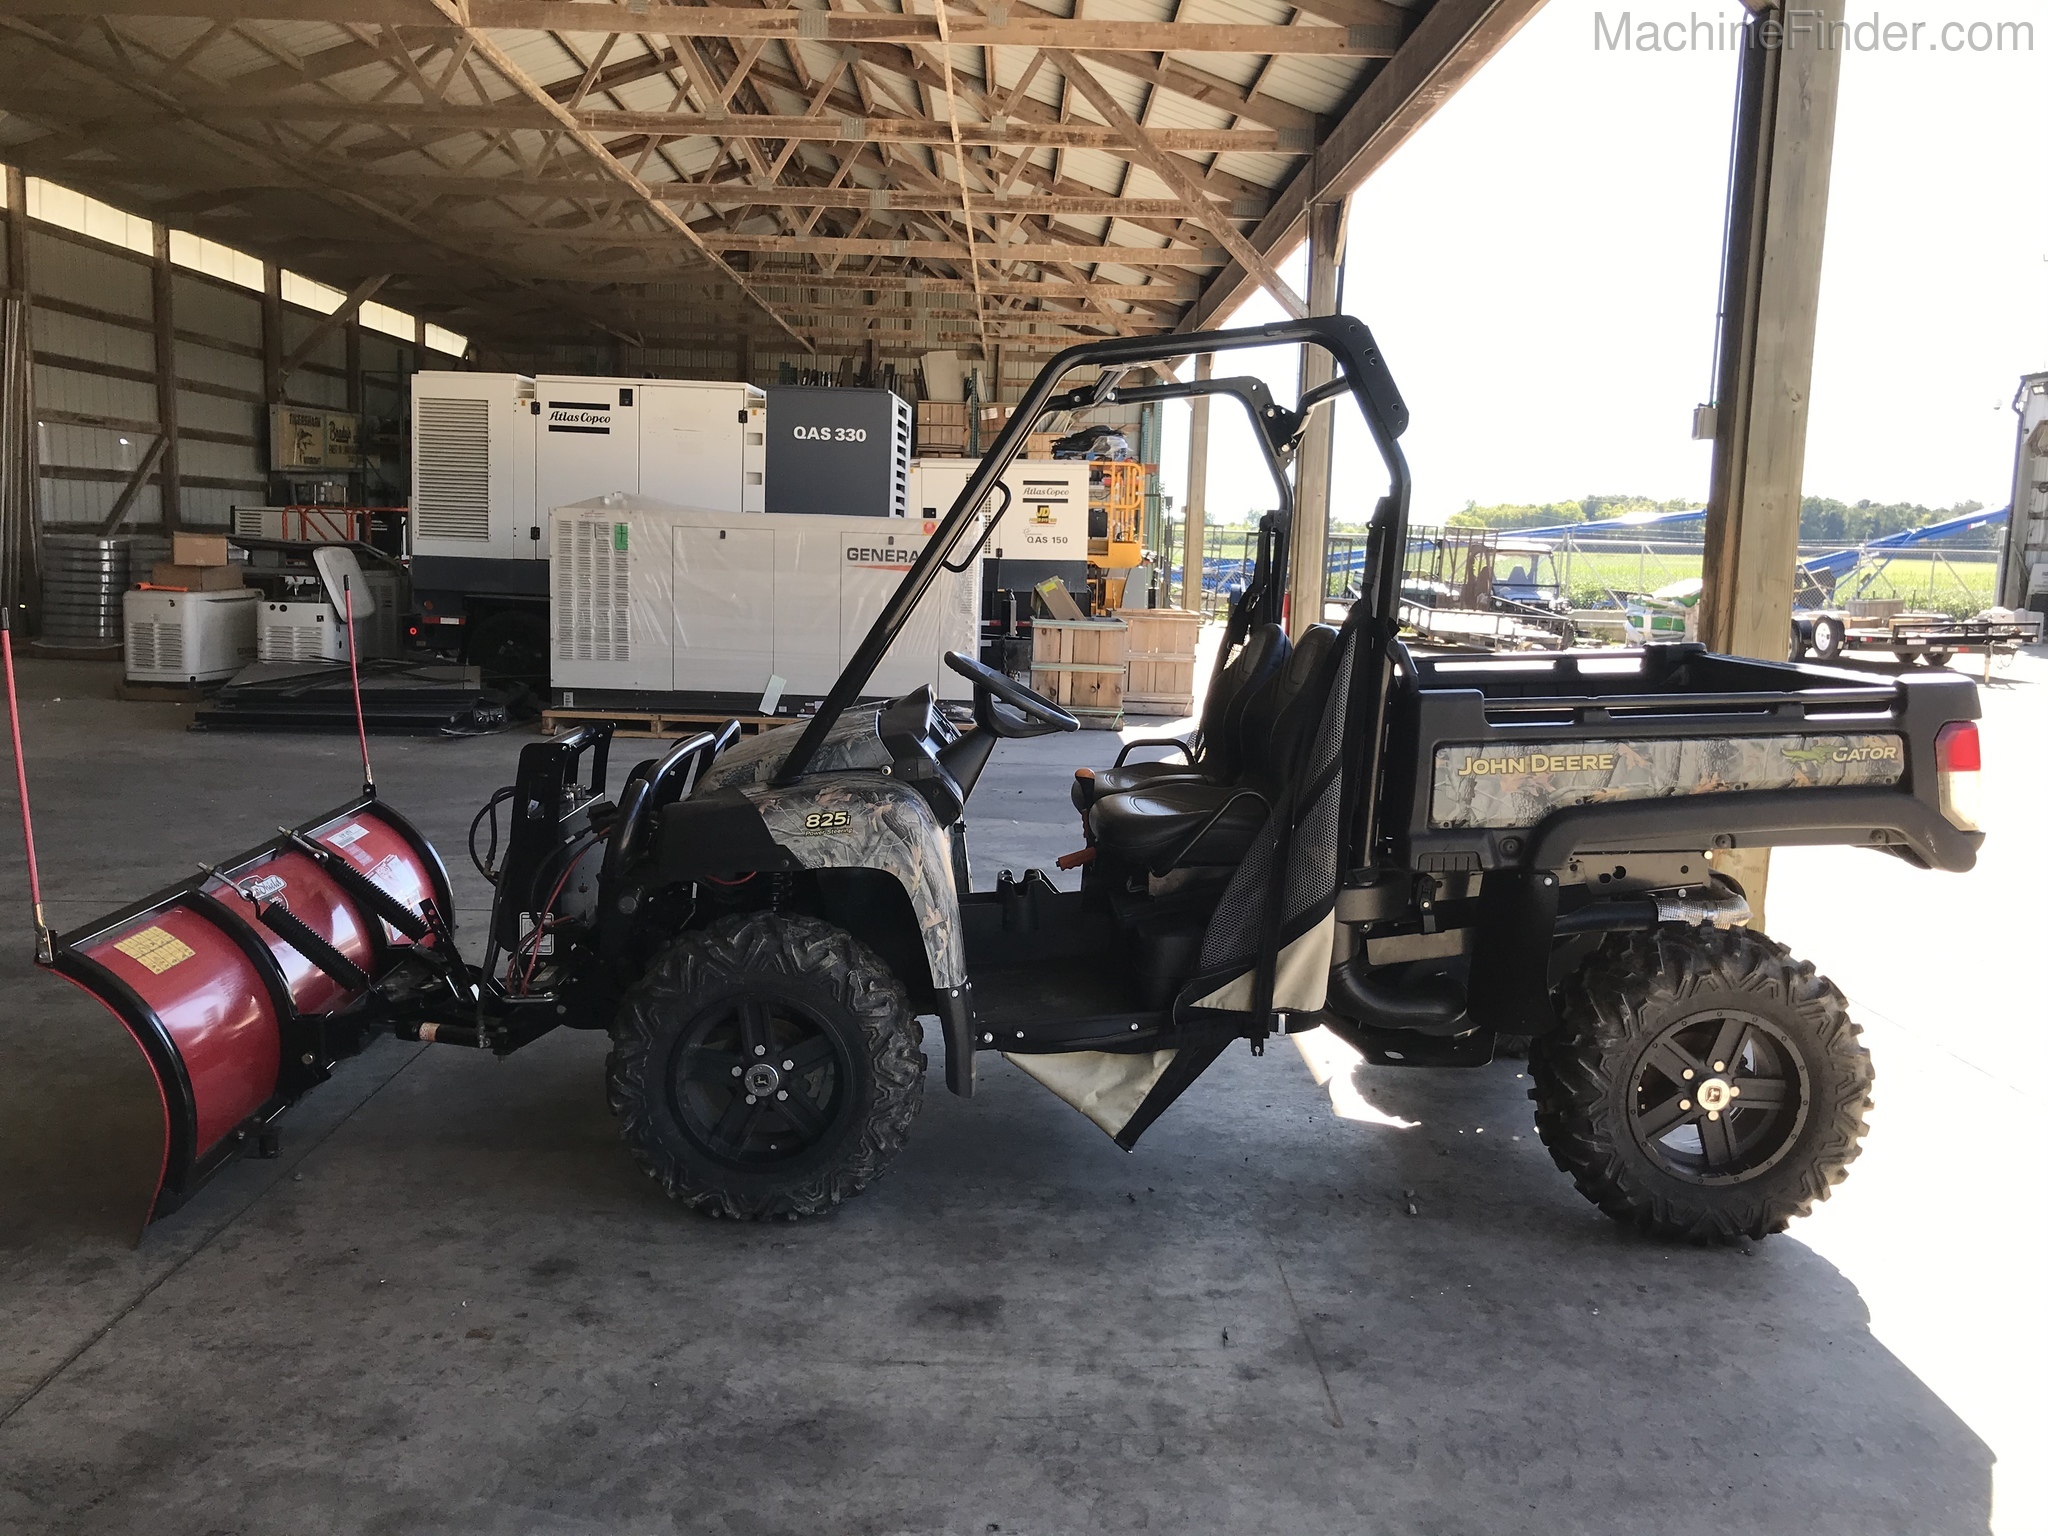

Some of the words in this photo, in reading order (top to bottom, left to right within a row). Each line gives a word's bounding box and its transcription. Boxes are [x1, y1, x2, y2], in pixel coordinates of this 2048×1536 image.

[548, 411, 579, 422] Atlas
[580, 412, 611, 425] Copco
[793, 426, 832, 440] QAS
[834, 428, 867, 442] 330
[1023, 487, 1046, 496] Atlas
[1046, 487, 1069, 497] Copco
[1026, 536, 1048, 544] QAS
[1051, 536, 1068, 544] 150
[846, 547, 920, 563] GENERA
[1832, 746, 1897, 762] GATOR
[806, 811, 851, 828] 825i
